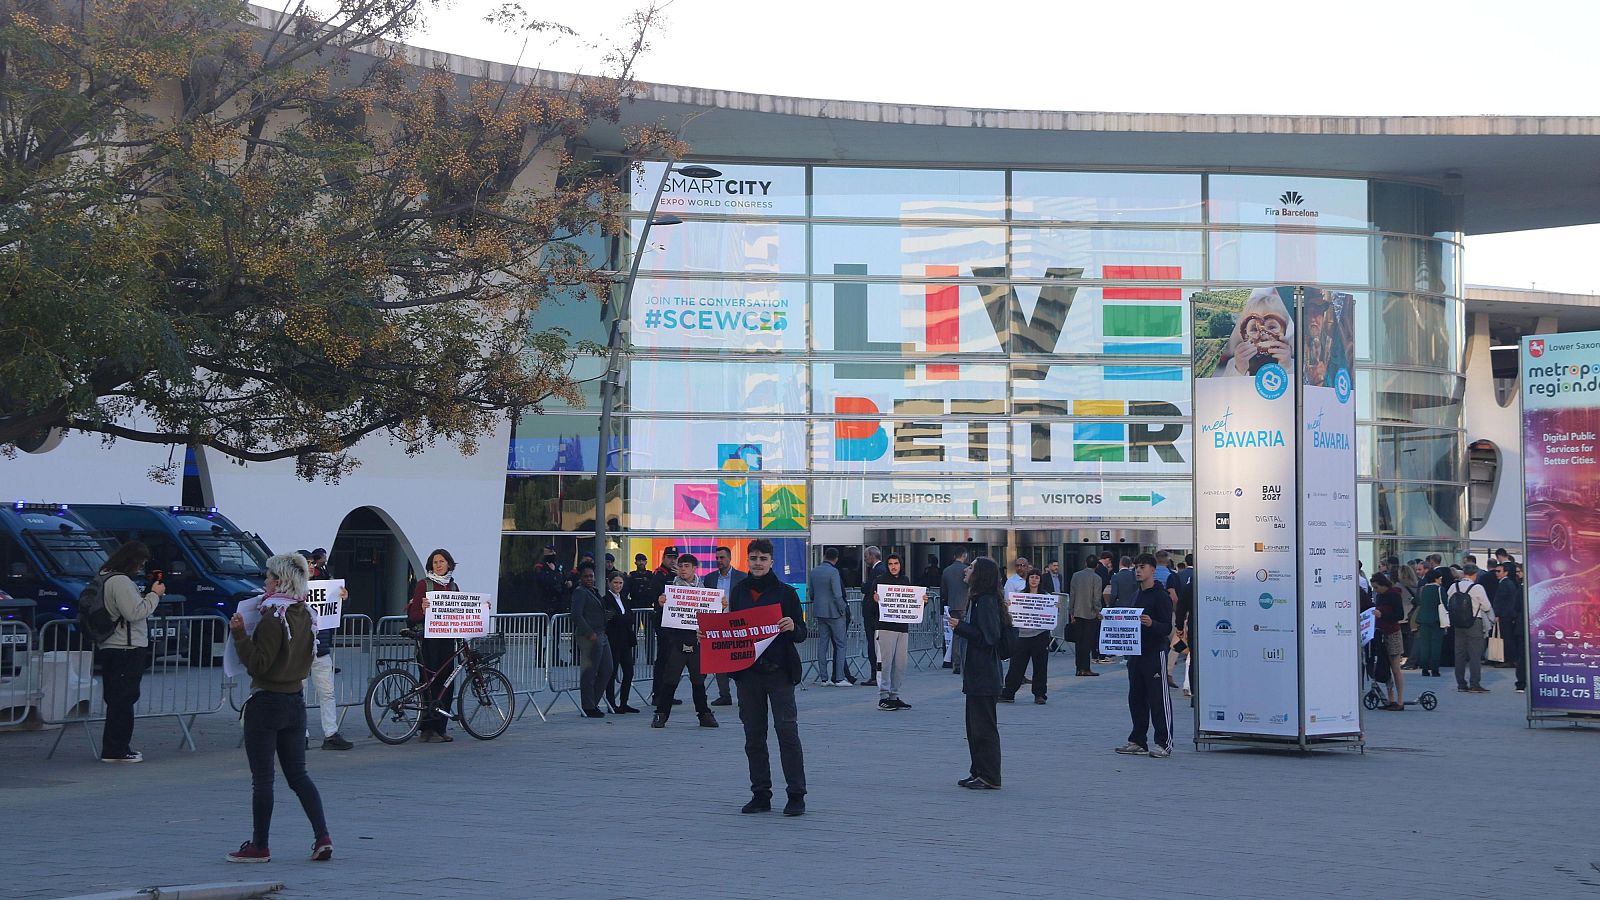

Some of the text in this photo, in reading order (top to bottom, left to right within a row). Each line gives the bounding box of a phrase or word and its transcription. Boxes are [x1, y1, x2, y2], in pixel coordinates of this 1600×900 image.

[724, 200, 773, 208] CONGRESS
[1265, 207, 1319, 217] Fira Barcelona
[645, 296, 789, 308] JOIN THE CONVERSATION
[834, 263, 1182, 380] LIVE
[1549, 343, 1574, 351] Lower
[1529, 362, 1600, 380] metropo
[1529, 375, 1600, 398] region.d
[1201, 406, 1233, 432] meet
[835, 396, 1185, 463] BETTER
[1214, 430, 1286, 448] BAVARIA
[1313, 431, 1350, 450] BAVARIA
[1543, 432, 1596, 443] Digital Public
[1546, 444, 1593, 453] Services for
[1544, 456, 1597, 465] Better Cities.
[871, 493, 952, 503] EXHIBITORS
[1041, 494, 1102, 504] VISITORS
[305, 588, 327, 602] REE
[310, 602, 338, 616] STINE
[706, 630, 720, 638] PUT
[722, 630, 732, 638] AN
[733, 629, 747, 637] END
[749, 626, 759, 635] TO
[712, 639, 754, 650] COMPLICITY
[1539, 674, 1586, 684] Find Us in
[1540, 688, 1591, 698] Hall 2: C75
